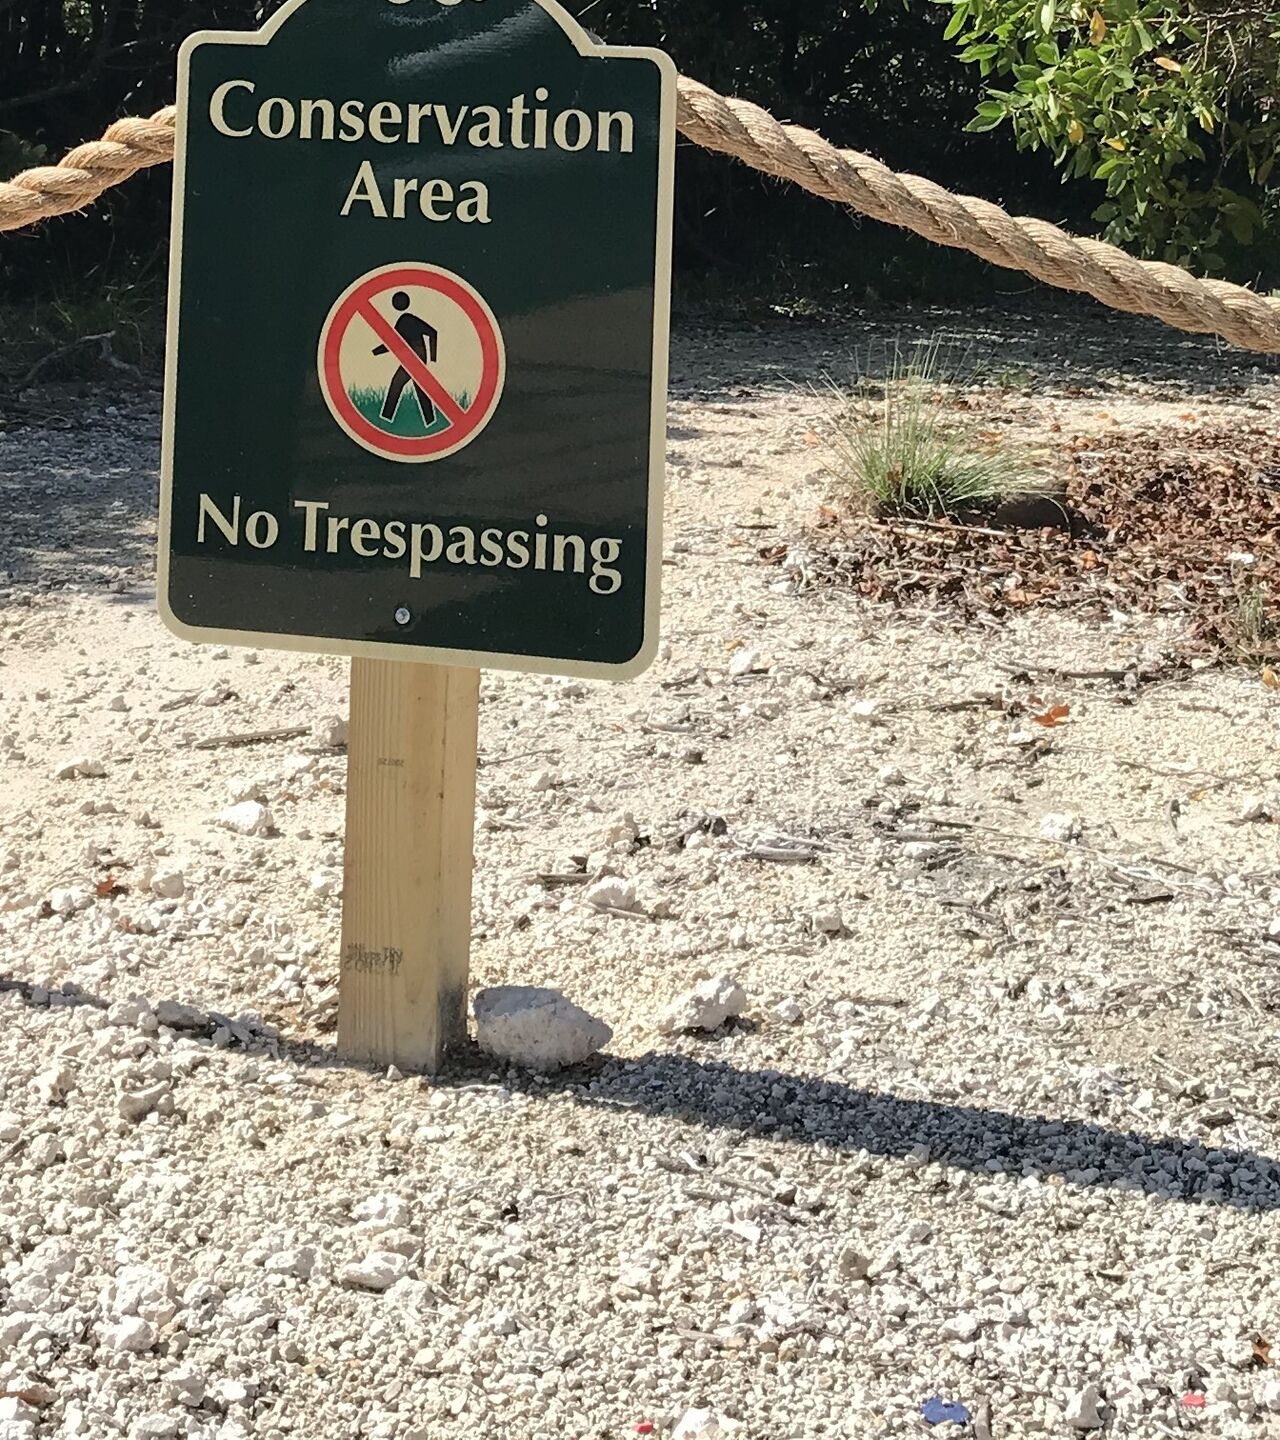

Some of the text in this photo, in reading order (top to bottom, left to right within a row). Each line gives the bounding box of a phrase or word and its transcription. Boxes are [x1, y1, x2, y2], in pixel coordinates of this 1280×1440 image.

[209, 79, 634, 153] Conservation
[340, 160, 492, 224] Area
[197, 493, 623, 594] No Trespassing
